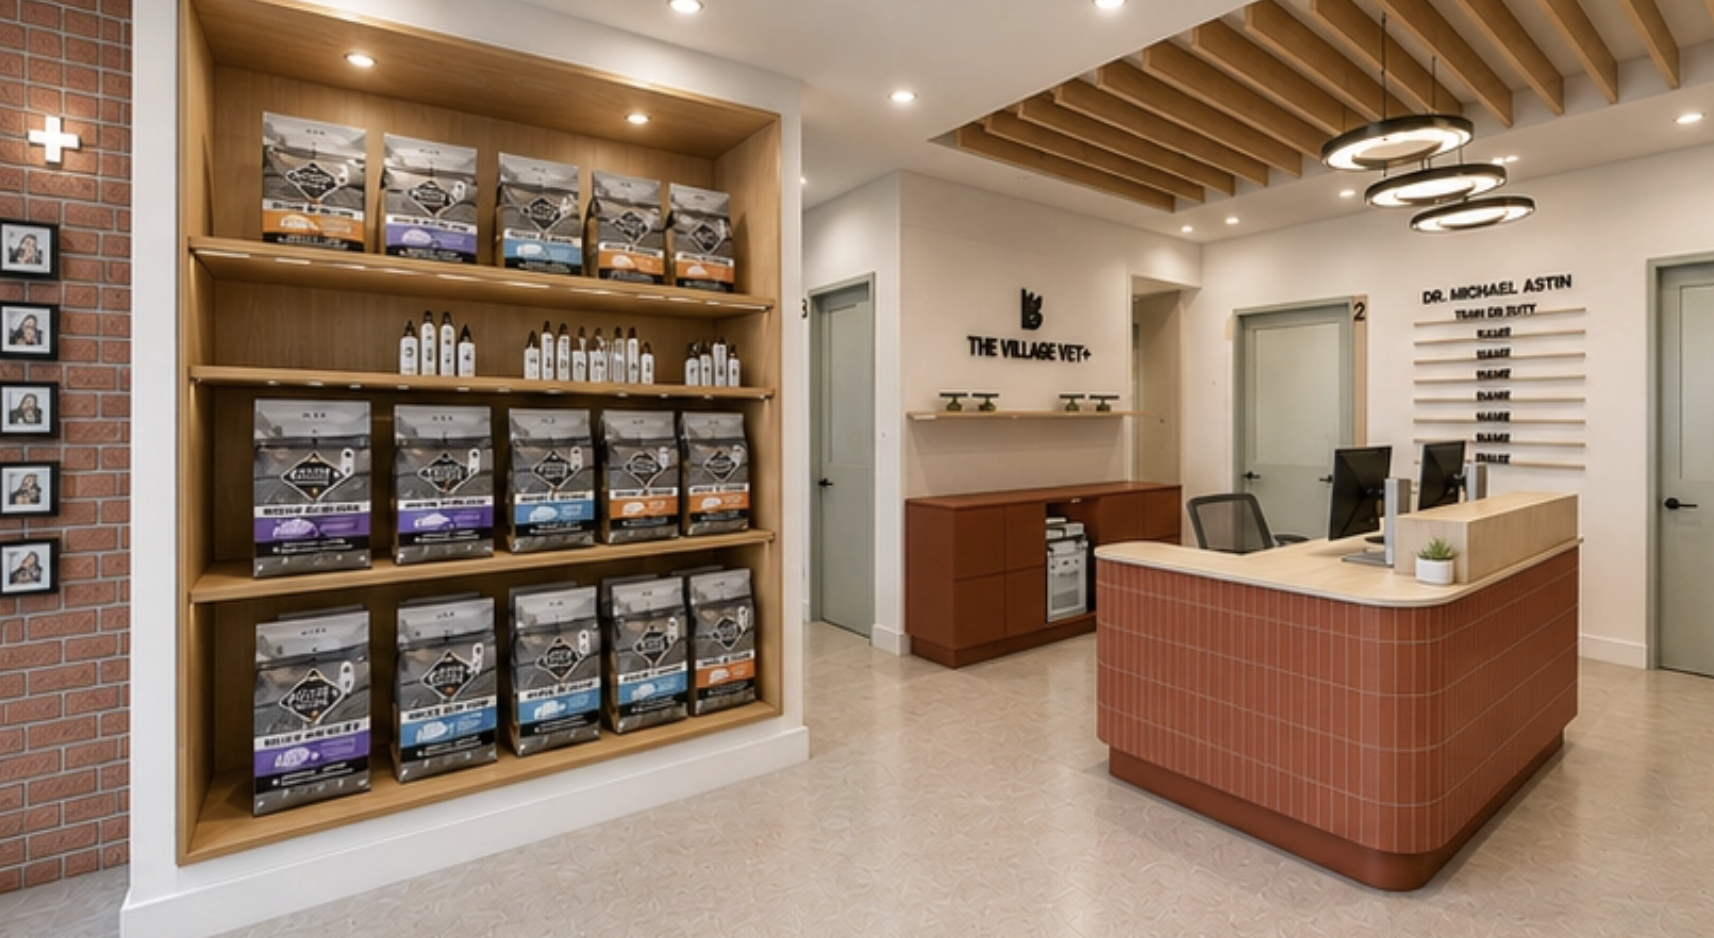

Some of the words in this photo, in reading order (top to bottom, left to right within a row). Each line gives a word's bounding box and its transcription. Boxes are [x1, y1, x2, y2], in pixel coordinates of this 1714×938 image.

[1422, 290, 1447, 305] DR.
[1450, 281, 1518, 300] MICHAEL
[1523, 274, 1572, 293] ASTIN
[1353, 301, 1366, 322] 2
[967, 335, 998, 356] THE
[1000, 338, 1056, 361] VILLAGE
